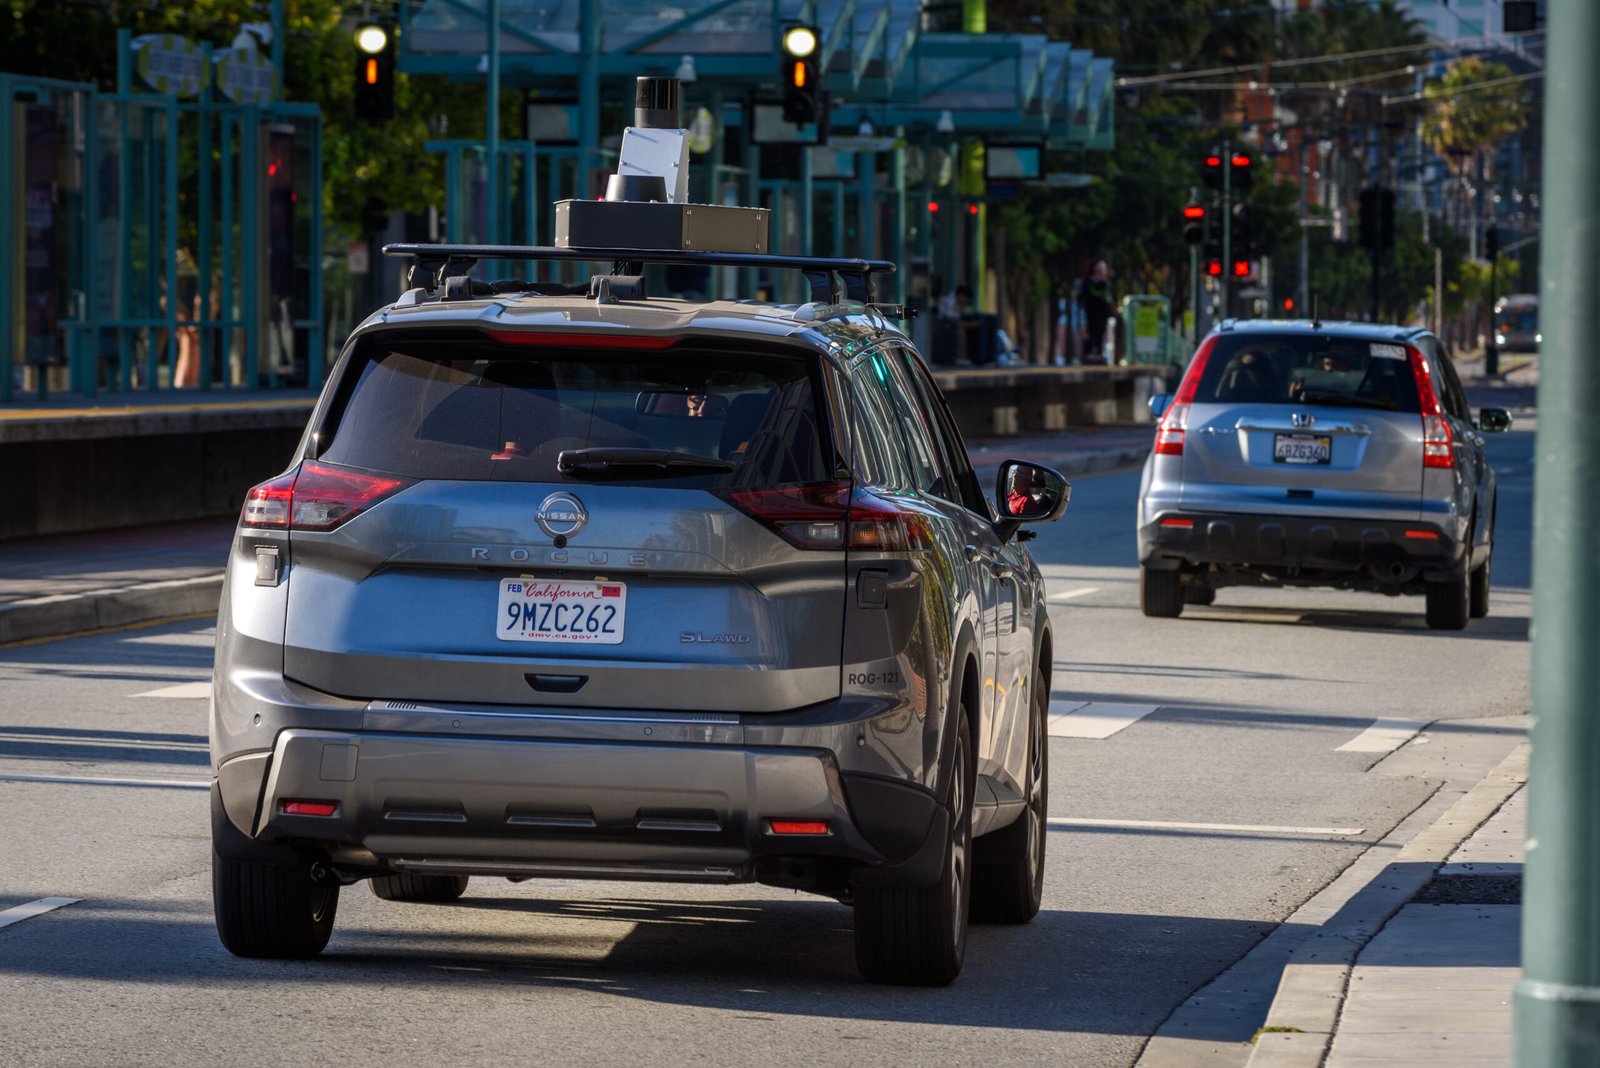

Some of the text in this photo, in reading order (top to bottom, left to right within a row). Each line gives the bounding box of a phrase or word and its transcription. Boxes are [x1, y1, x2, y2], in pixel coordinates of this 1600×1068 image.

[538, 511, 587, 521] NISSAN
[471, 548, 648, 567] ROGUE
[507, 583, 522, 593] FEB
[525, 582, 603, 603] California
[506, 602, 617, 633] 9MZC262
[528, 631, 592, 640] dmv.ca.gov
[848, 671, 899, 685] ROG-121
